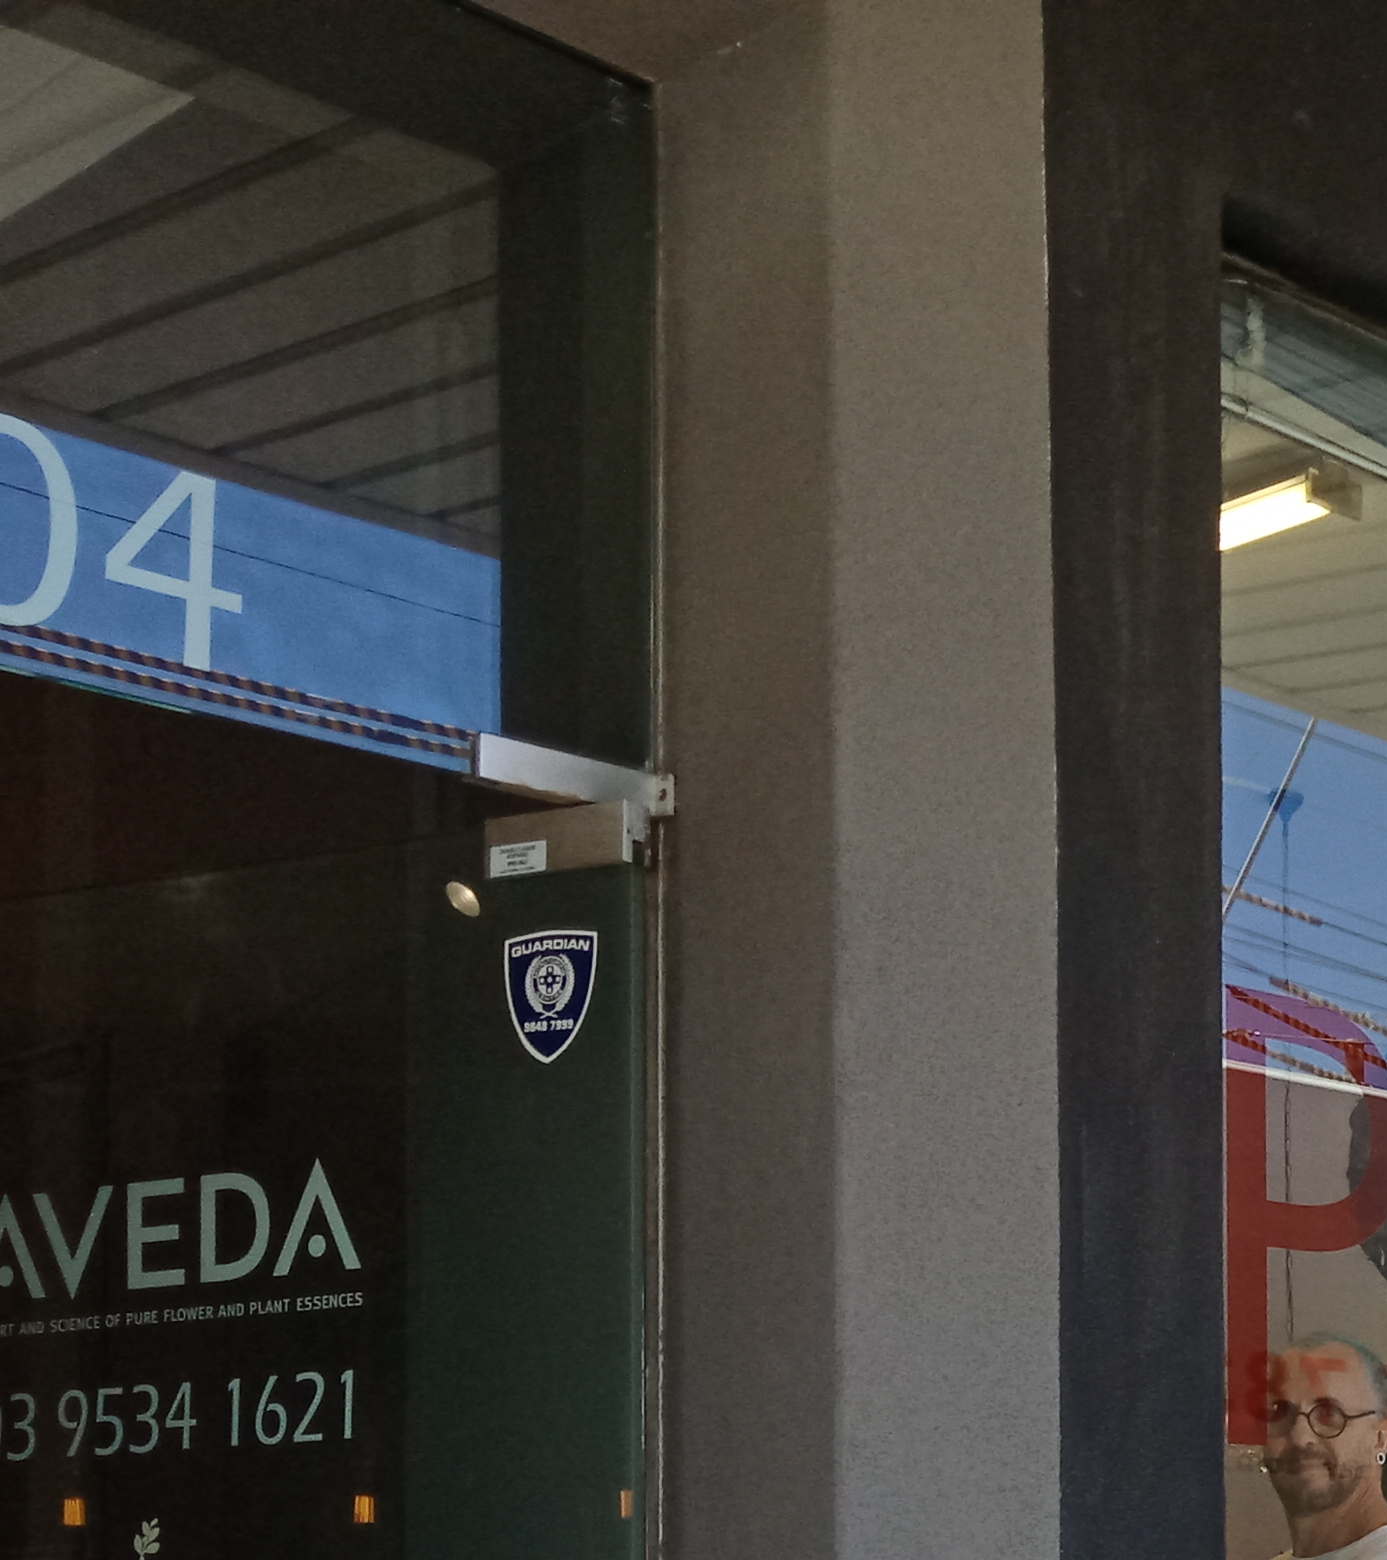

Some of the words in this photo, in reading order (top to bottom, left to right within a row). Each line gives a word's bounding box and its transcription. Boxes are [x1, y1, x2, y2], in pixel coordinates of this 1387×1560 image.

[511, 939, 590, 957] GUARDIAN
[18, 1321, 44, 1335] AND
[50, 1316, 101, 1333] SCIENCE
[105, 1313, 122, 1328] OF
[126, 1310, 158, 1326] PURE
[163, 1305, 214, 1323] FLOWER
[217, 1303, 245, 1318] AND
[249, 1298, 290, 1315] PLANT
[296, 1291, 363, 1312] ESSENCES
[0, 1393, 37, 1462] 3
[57, 1381, 197, 1458] 9534
[227, 1369, 354, 1447] 1621
